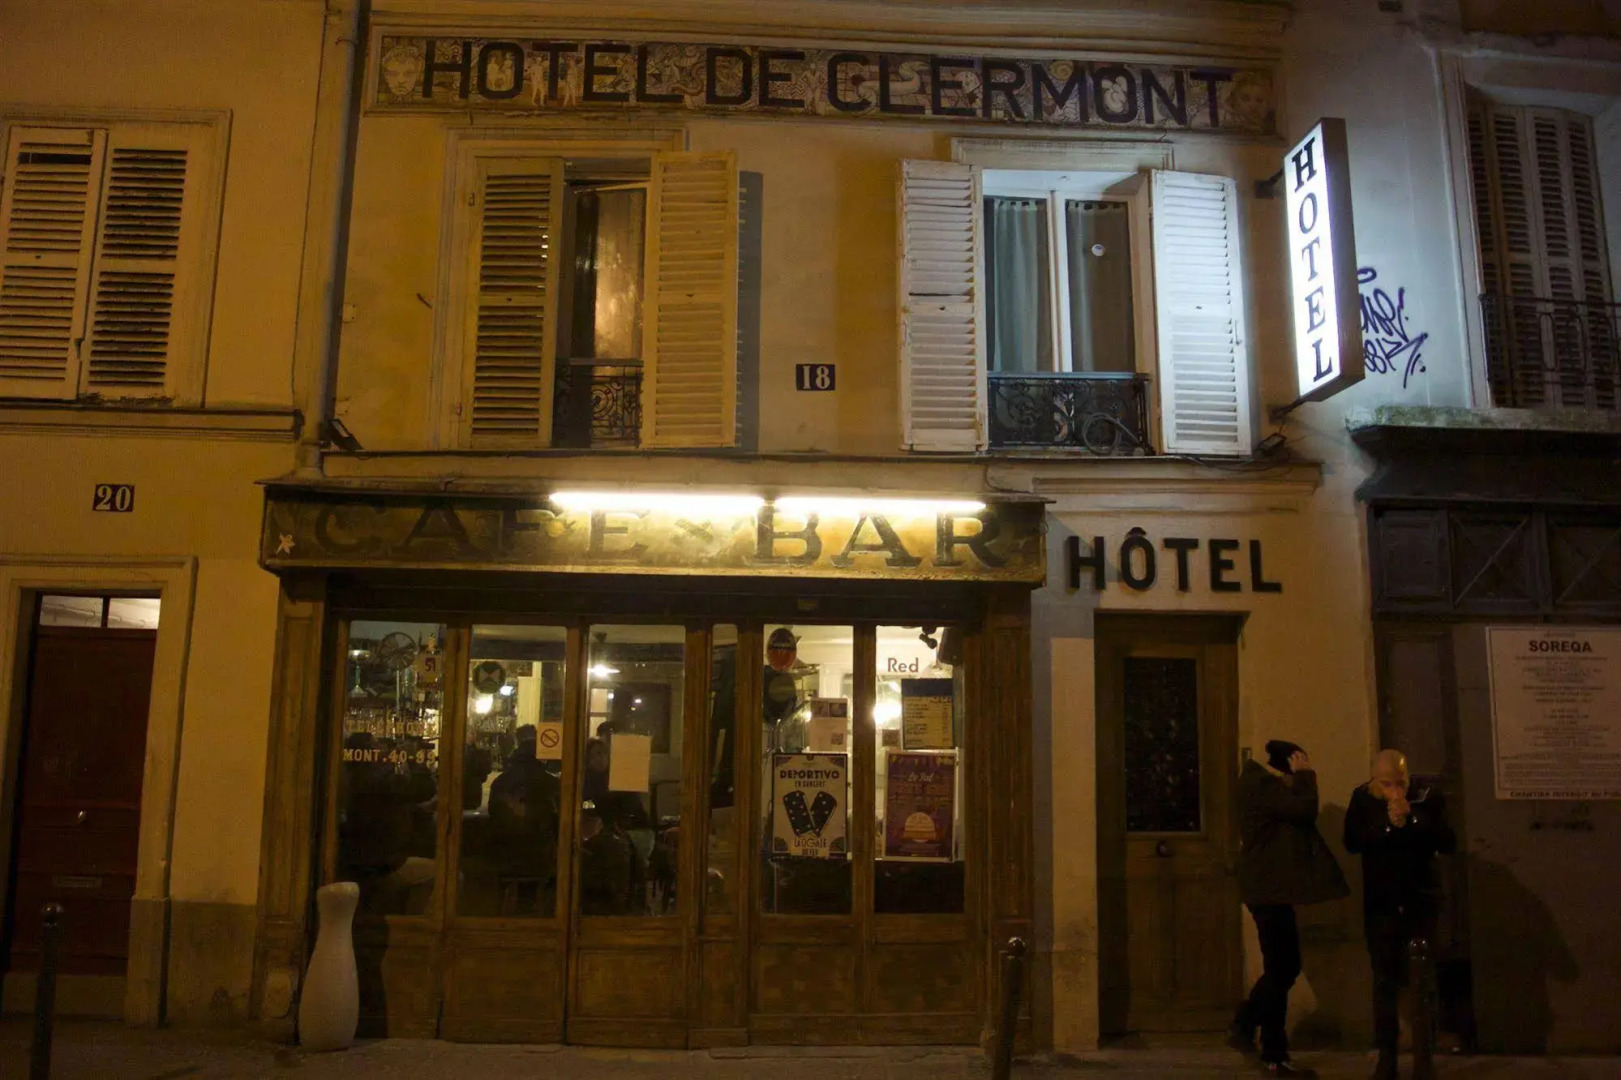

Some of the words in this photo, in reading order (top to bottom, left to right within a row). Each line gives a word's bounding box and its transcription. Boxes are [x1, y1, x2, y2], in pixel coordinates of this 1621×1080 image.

[422, 40, 685, 102] HOTEL
[705, 48, 806, 108] DE
[827, 53, 1232, 128] CLERMONT
[1291, 136, 1334, 384] HOTEL
[802, 365, 831, 389] 18
[95, 485, 131, 511] 20
[750, 504, 1006, 568] BAR
[1067, 526, 1283, 593] HÔTEL
[1529, 640, 1592, 653] SOREQA
[888, 657, 919, 673] Red
[780, 769, 840, 779] DEPORTIVO
